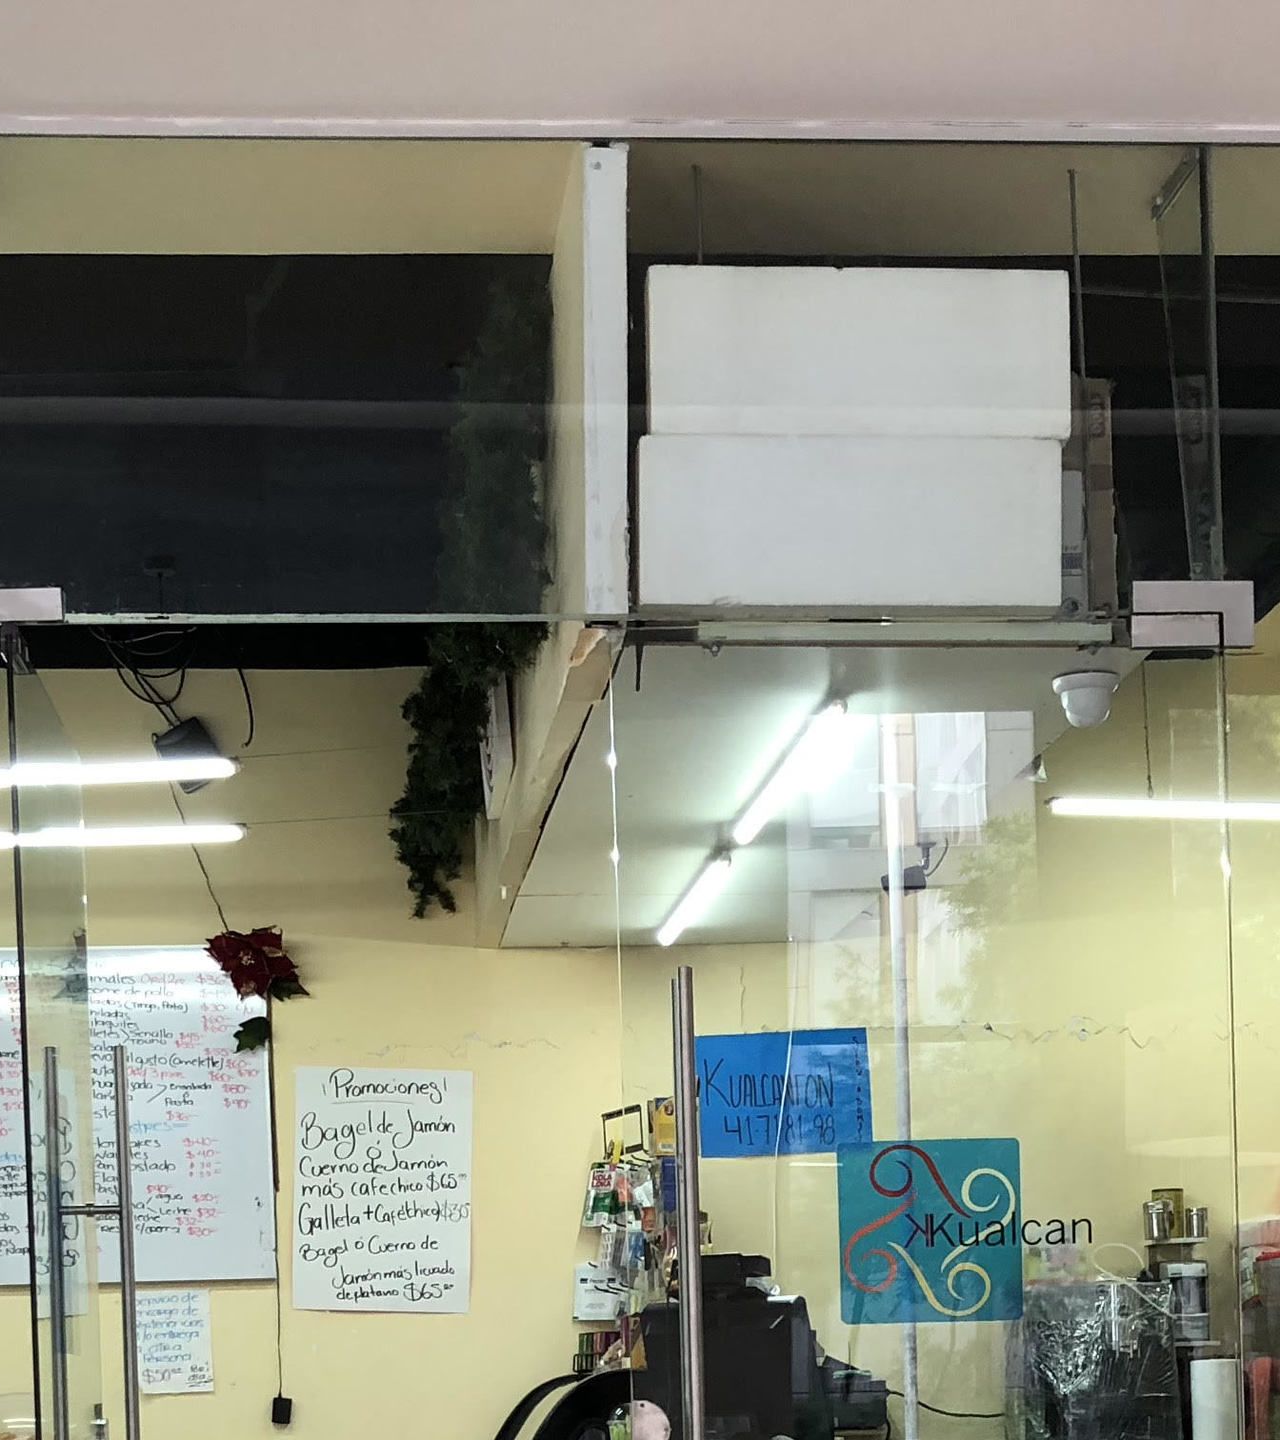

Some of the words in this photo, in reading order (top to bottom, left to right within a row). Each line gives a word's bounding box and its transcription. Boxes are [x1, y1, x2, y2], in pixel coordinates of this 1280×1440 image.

[703, 1058, 834, 1109] KUALCANFON
[301, 1109, 372, 1160] Bagel
[376, 1110, 394, 1134] de
[392, 1108, 456, 1150] Jamón
[129, 1161, 177, 1172] ostado
[299, 1155, 359, 1177] Cuerno
[592, 1173, 612, 1181] KOLA
[302, 1177, 344, 1199] más
[591, 1180, 612, 1188] LOKA
[298, 1202, 360, 1236] Galleta
[928, 1212, 1093, 1248] Kualcan
[299, 1239, 348, 1268] Bagel
[368, 1234, 416, 1255] Cuerno
[420, 1234, 439, 1250] de
[332, 1265, 382, 1289] Jamón
[383, 1265, 413, 1281] más
